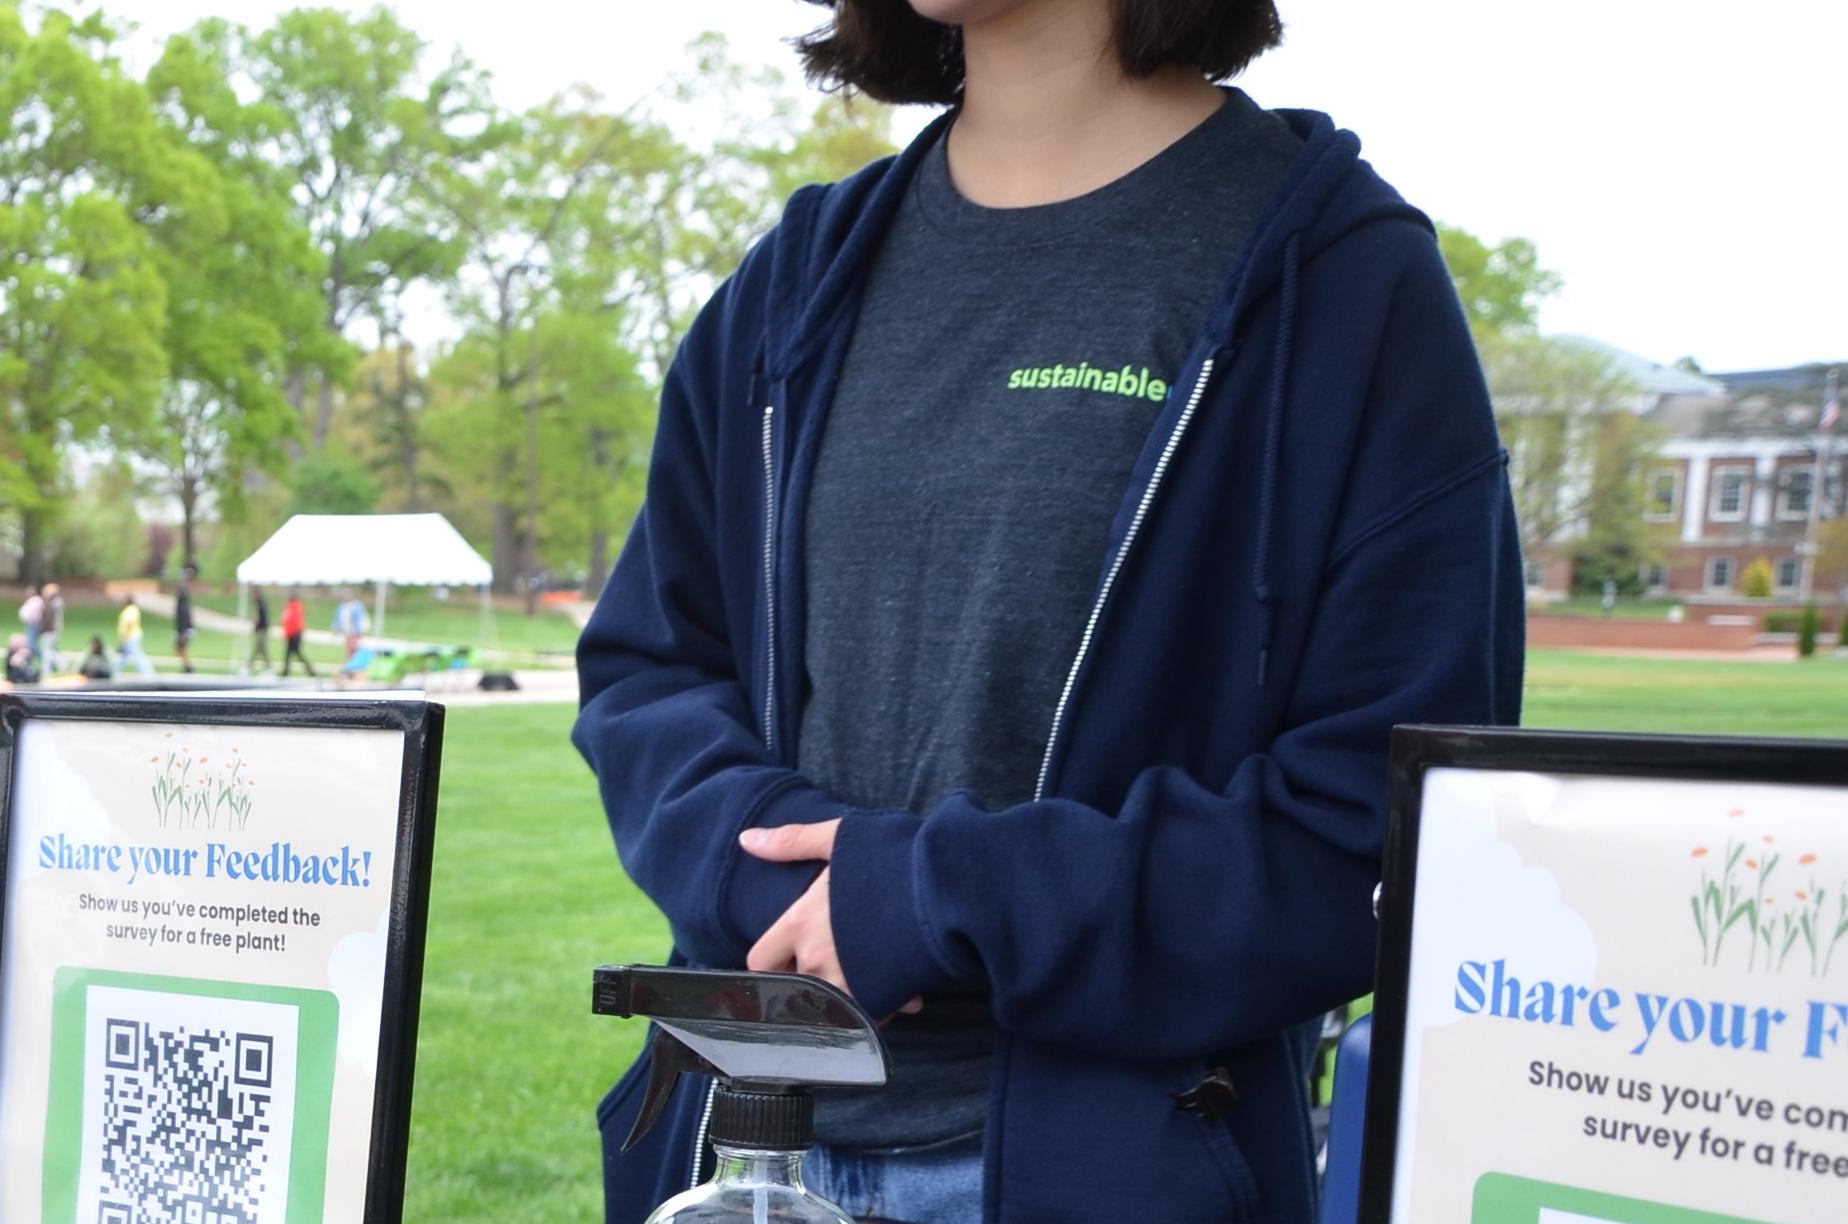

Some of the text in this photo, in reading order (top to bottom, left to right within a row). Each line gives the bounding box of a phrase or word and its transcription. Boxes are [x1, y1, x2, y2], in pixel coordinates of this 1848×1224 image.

[1008, 362, 1172, 401] sustainable
[39, 833, 372, 887] Share your Feedback!
[80, 894, 321, 927] Show us you've completed the
[106, 924, 287, 953] survey for a free plant!
[1454, 958, 1621, 1032] Share
[1630, 991, 1786, 1055] your
[1528, 1060, 1609, 1096] Show
[1617, 1076, 1652, 1102] us
[1661, 1083, 1774, 1120] you've
[1583, 1113, 1848, 1178] survey for a free
